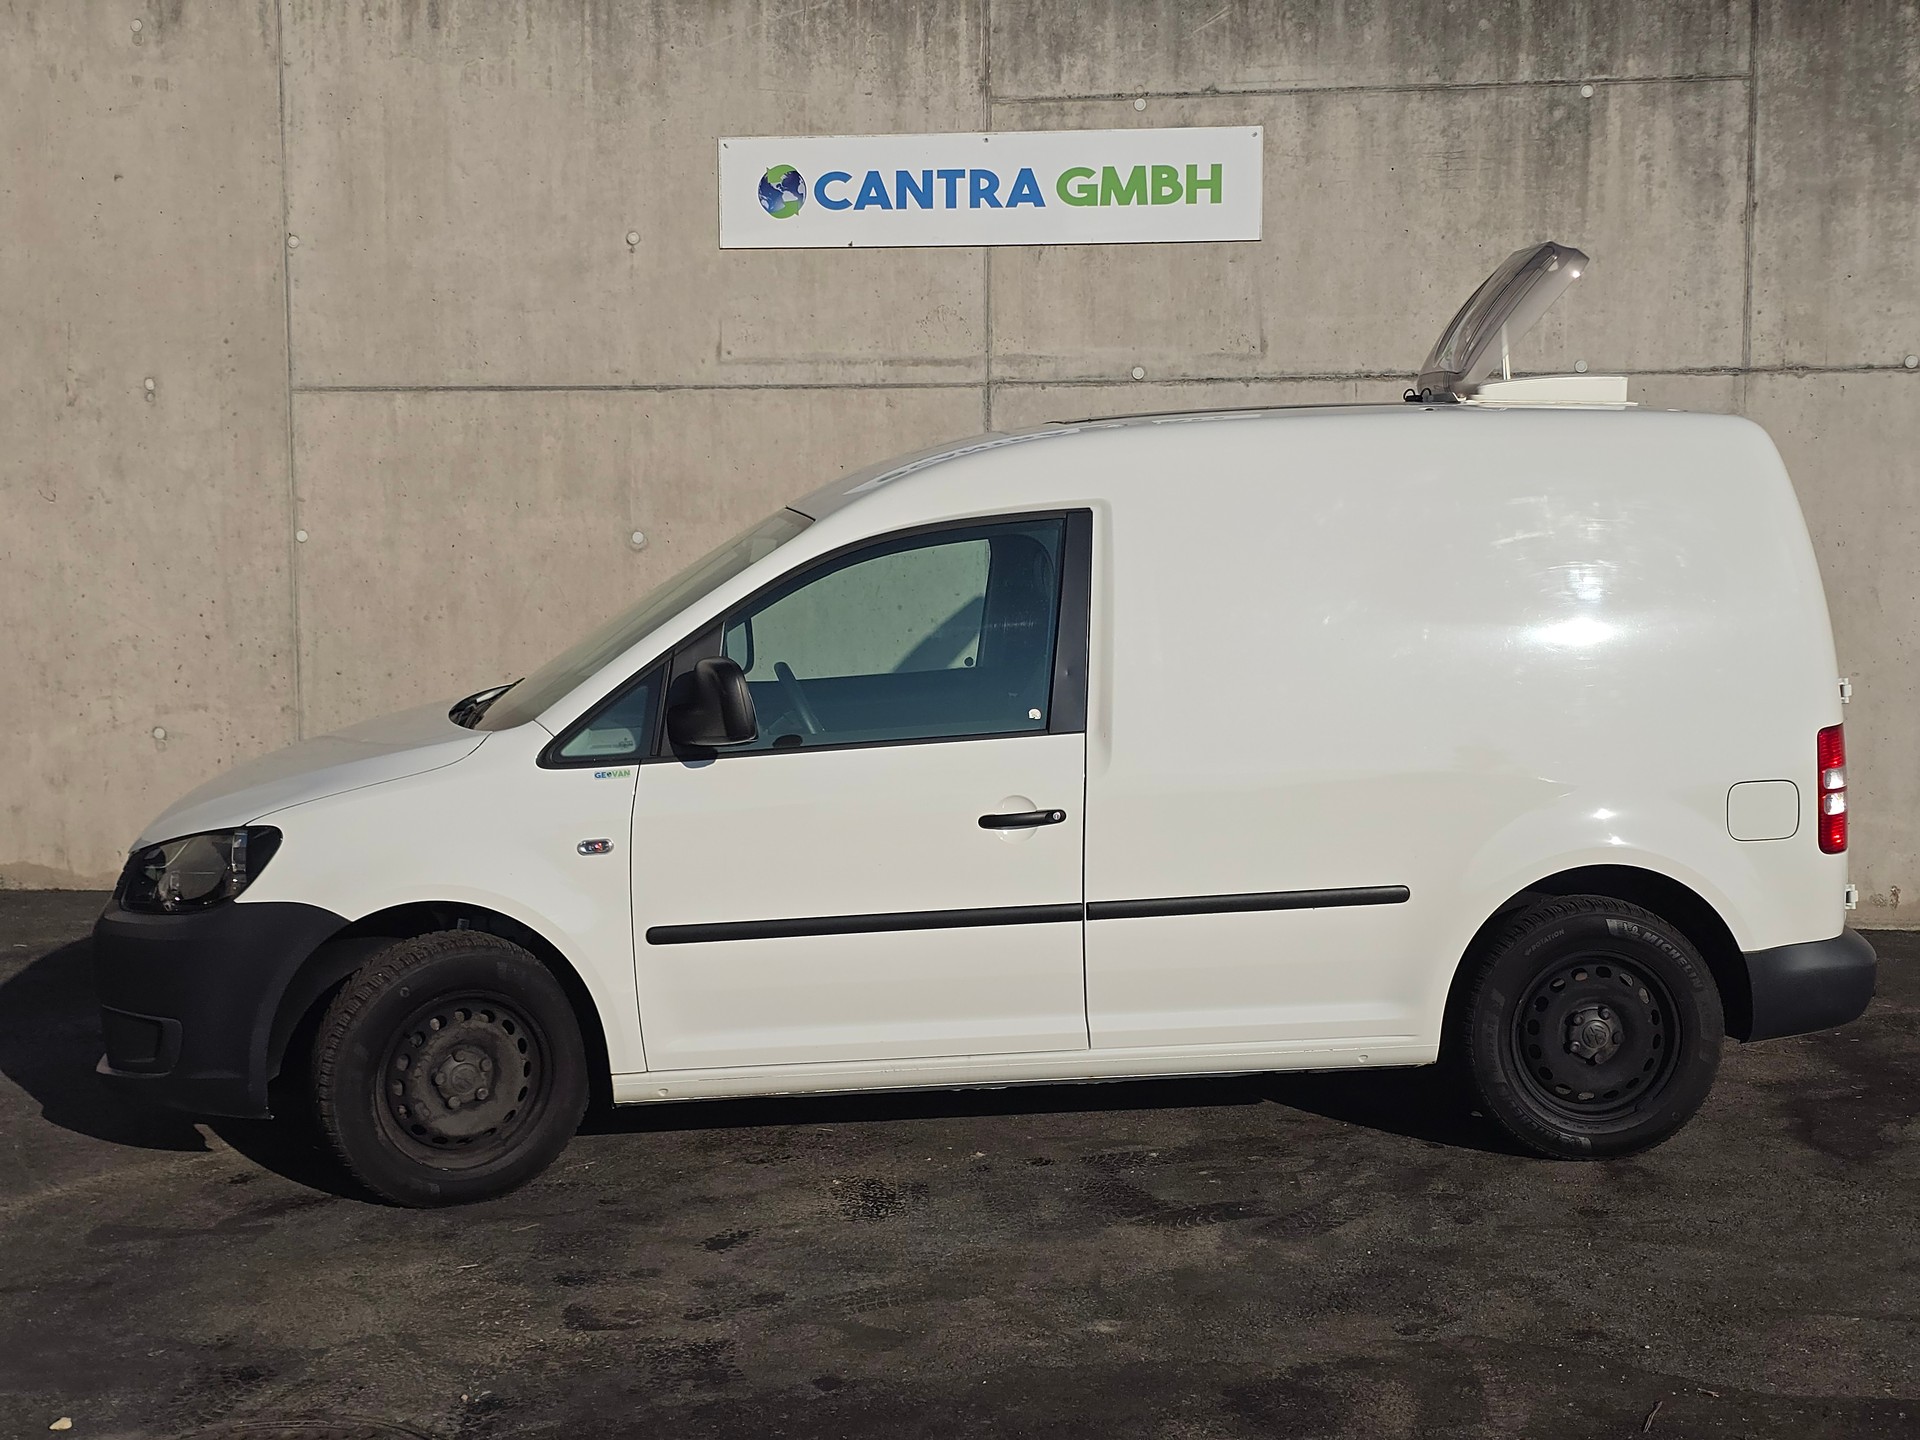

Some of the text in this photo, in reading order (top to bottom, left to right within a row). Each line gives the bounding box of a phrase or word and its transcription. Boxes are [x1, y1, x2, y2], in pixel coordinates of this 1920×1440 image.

[813, 163, 1222, 210] CANTRA GMBH
[1531, 928, 1564, 952] ROTATION
[1643, 932, 1703, 990] MICHELIN
